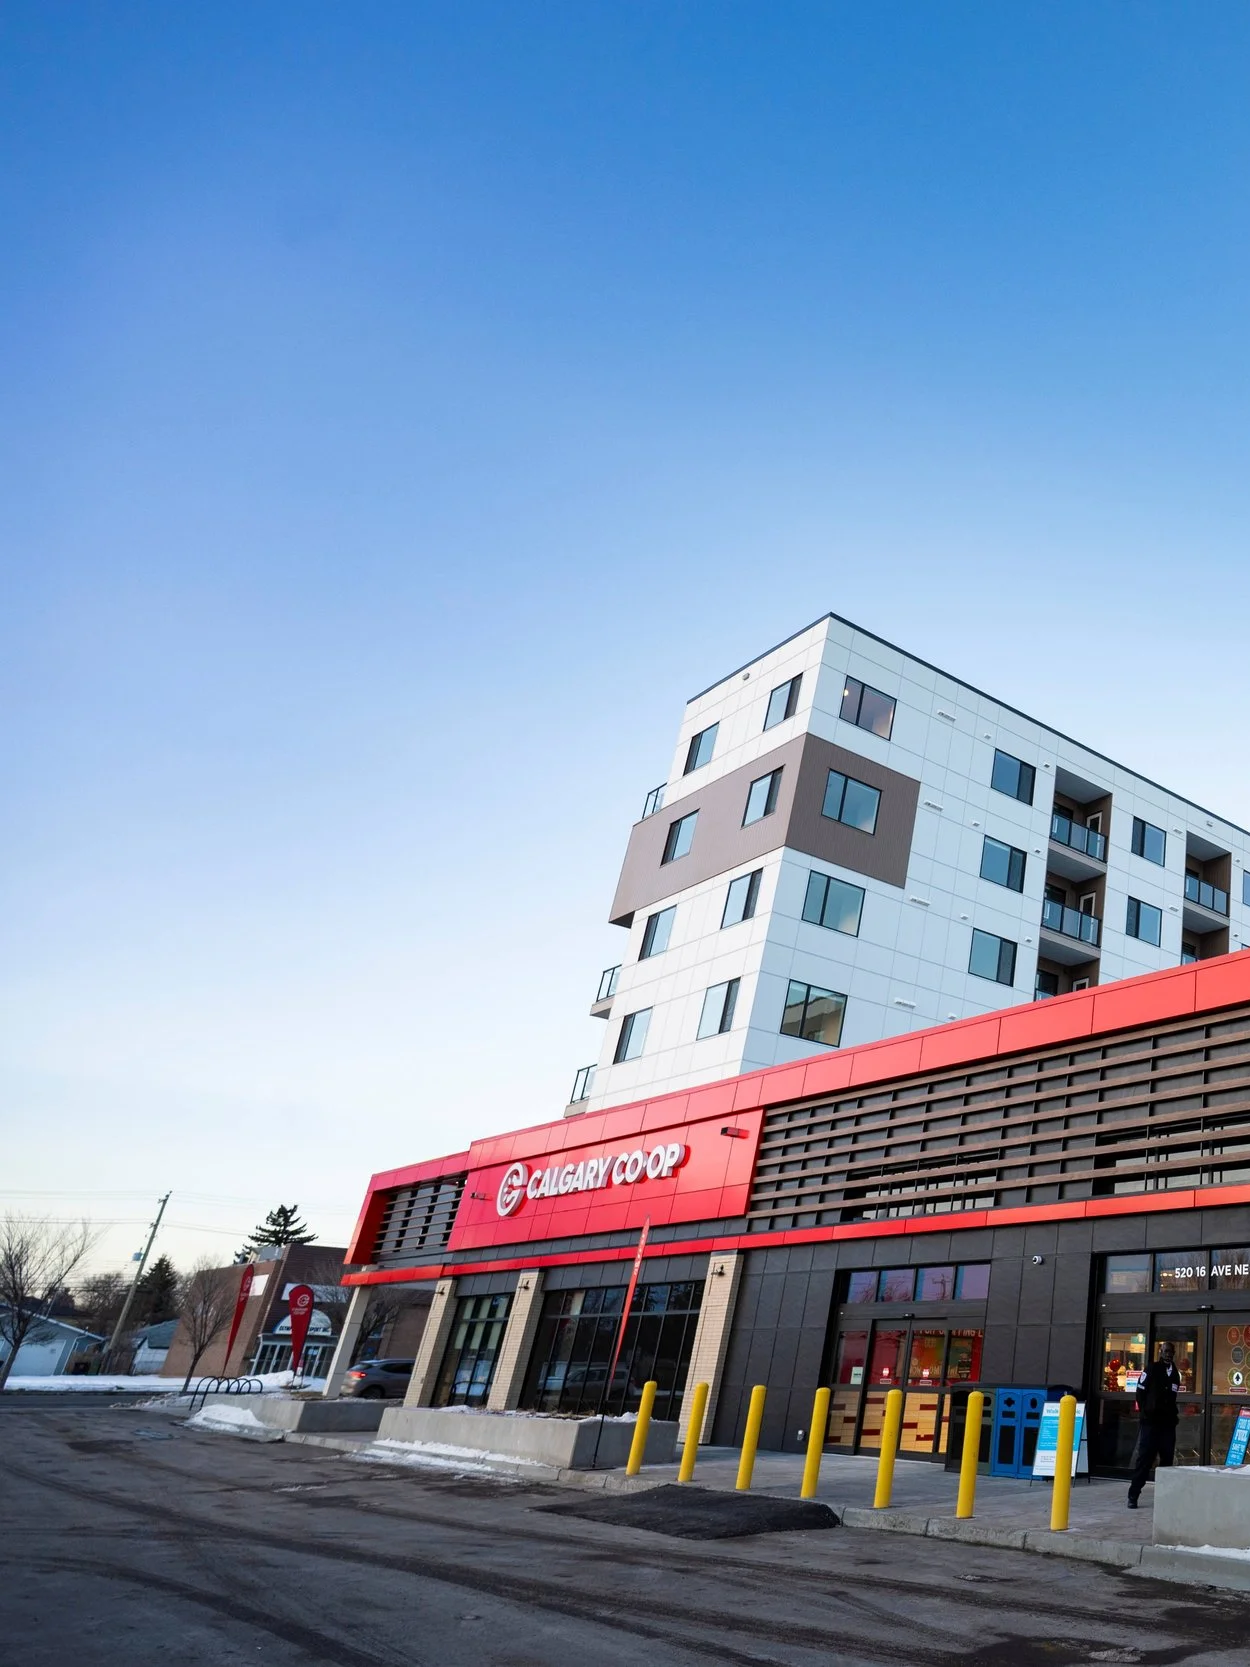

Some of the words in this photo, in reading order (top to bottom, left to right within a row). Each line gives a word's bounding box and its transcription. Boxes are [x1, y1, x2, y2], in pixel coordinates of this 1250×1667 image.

[526, 1156, 612, 1200] CALGARY
[1174, 1267, 1193, 1279] 520
[1195, 1266, 1206, 1278] 16
[1210, 1265, 1232, 1277] AVE
[1234, 1264, 1249, 1275] NE
